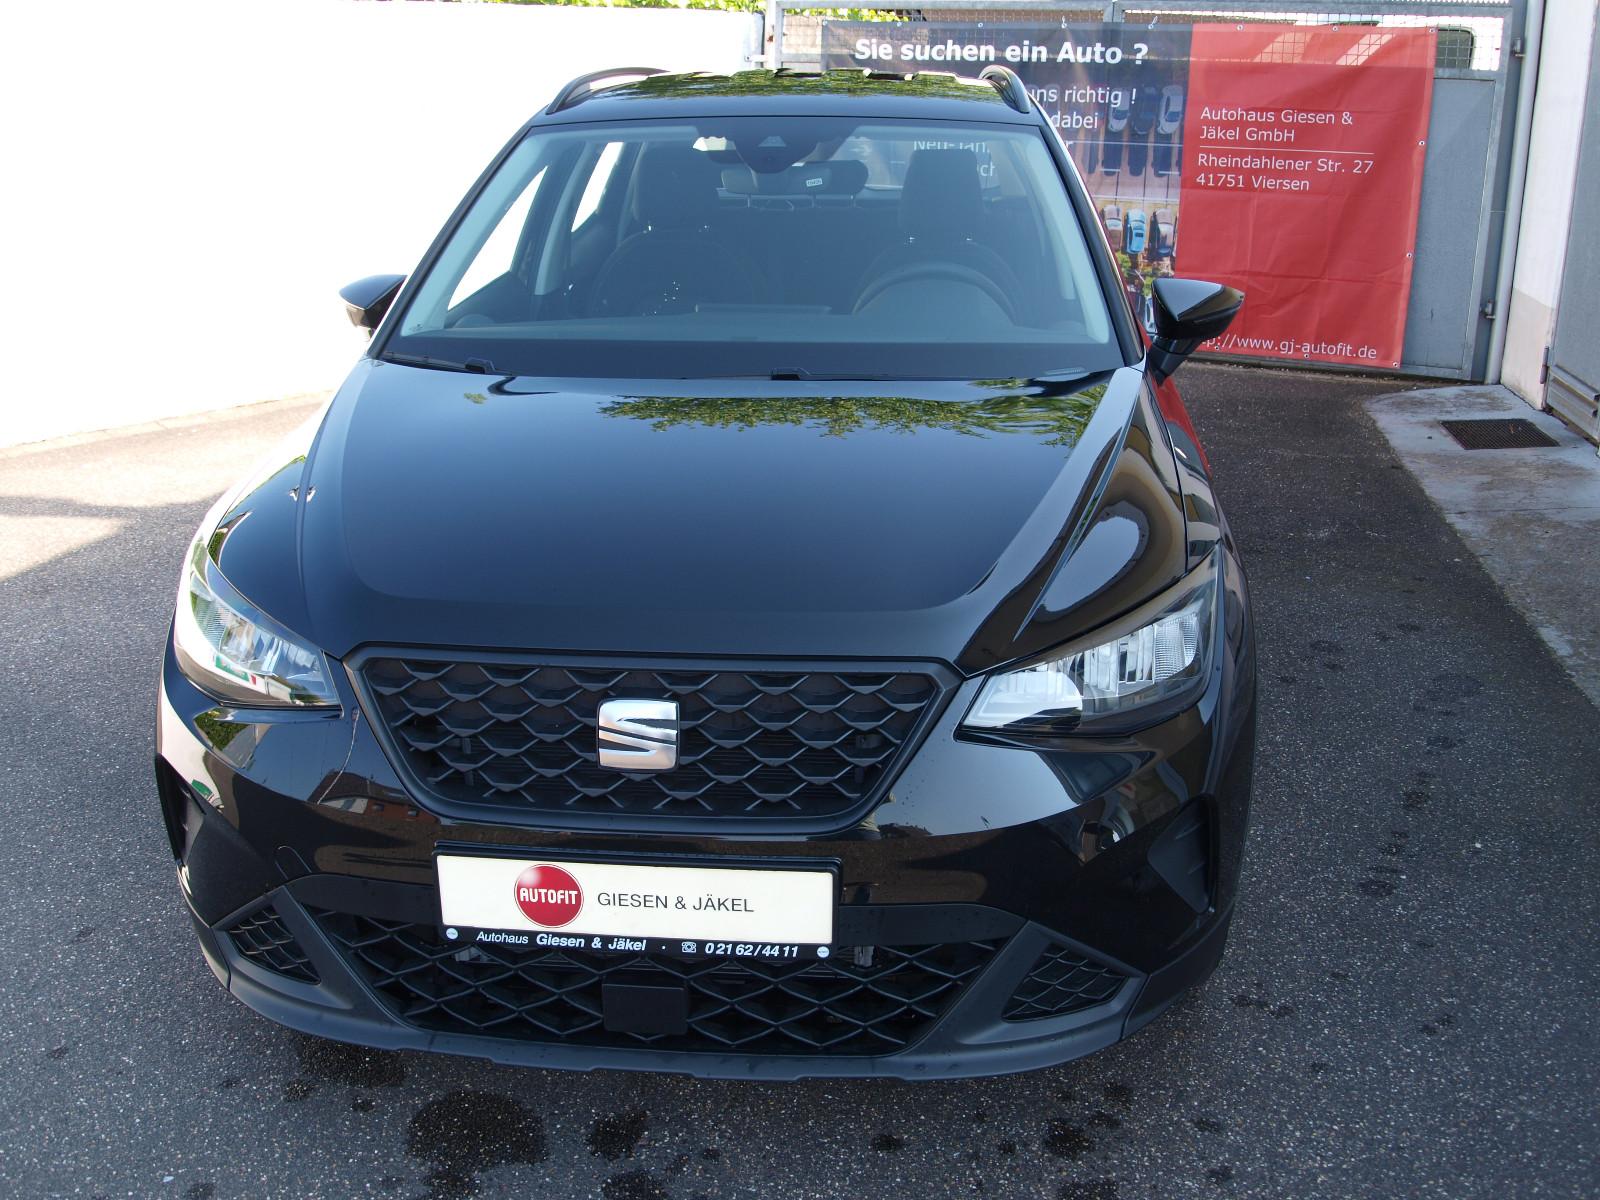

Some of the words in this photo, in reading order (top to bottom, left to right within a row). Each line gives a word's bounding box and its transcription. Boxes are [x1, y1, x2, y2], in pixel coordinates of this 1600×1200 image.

[855, 39, 893, 60] Sie
[900, 40, 995, 62] suchen
[1005, 41, 1048, 63] ein
[1056, 41, 1123, 65] Auto
[1133, 43, 1149, 65] ?
[1064, 86, 1122, 108] richtig
[1131, 88, 1137, 105] !
[1050, 111, 1099, 129] dabei
[1200, 107, 1275, 122] Autohaus
[1281, 109, 1335, 125] Giesen
[1341, 111, 1353, 125] &
[1199, 126, 1240, 140] Jäkel
[1245, 127, 1295, 142] GmbH
[1198, 153, 1312, 171] Rheindahlener
[1316, 159, 1345, 173] Str.
[1352, 160, 1374, 174] 27
[1196, 173, 1245, 188] 41751
[1251, 175, 1310, 191] Viersen
[1202, 333, 1377, 359] p://www.gj-autofit.de
[519, 887, 578, 905] AUTOFIT
[597, 892, 668, 909] GIESEN
[674, 895, 687, 910] &
[692, 893, 754, 913] JÄKEL
[476, 931, 529, 944] Autohaus
[536, 933, 585, 948] Giesen
[591, 936, 602, 949] &
